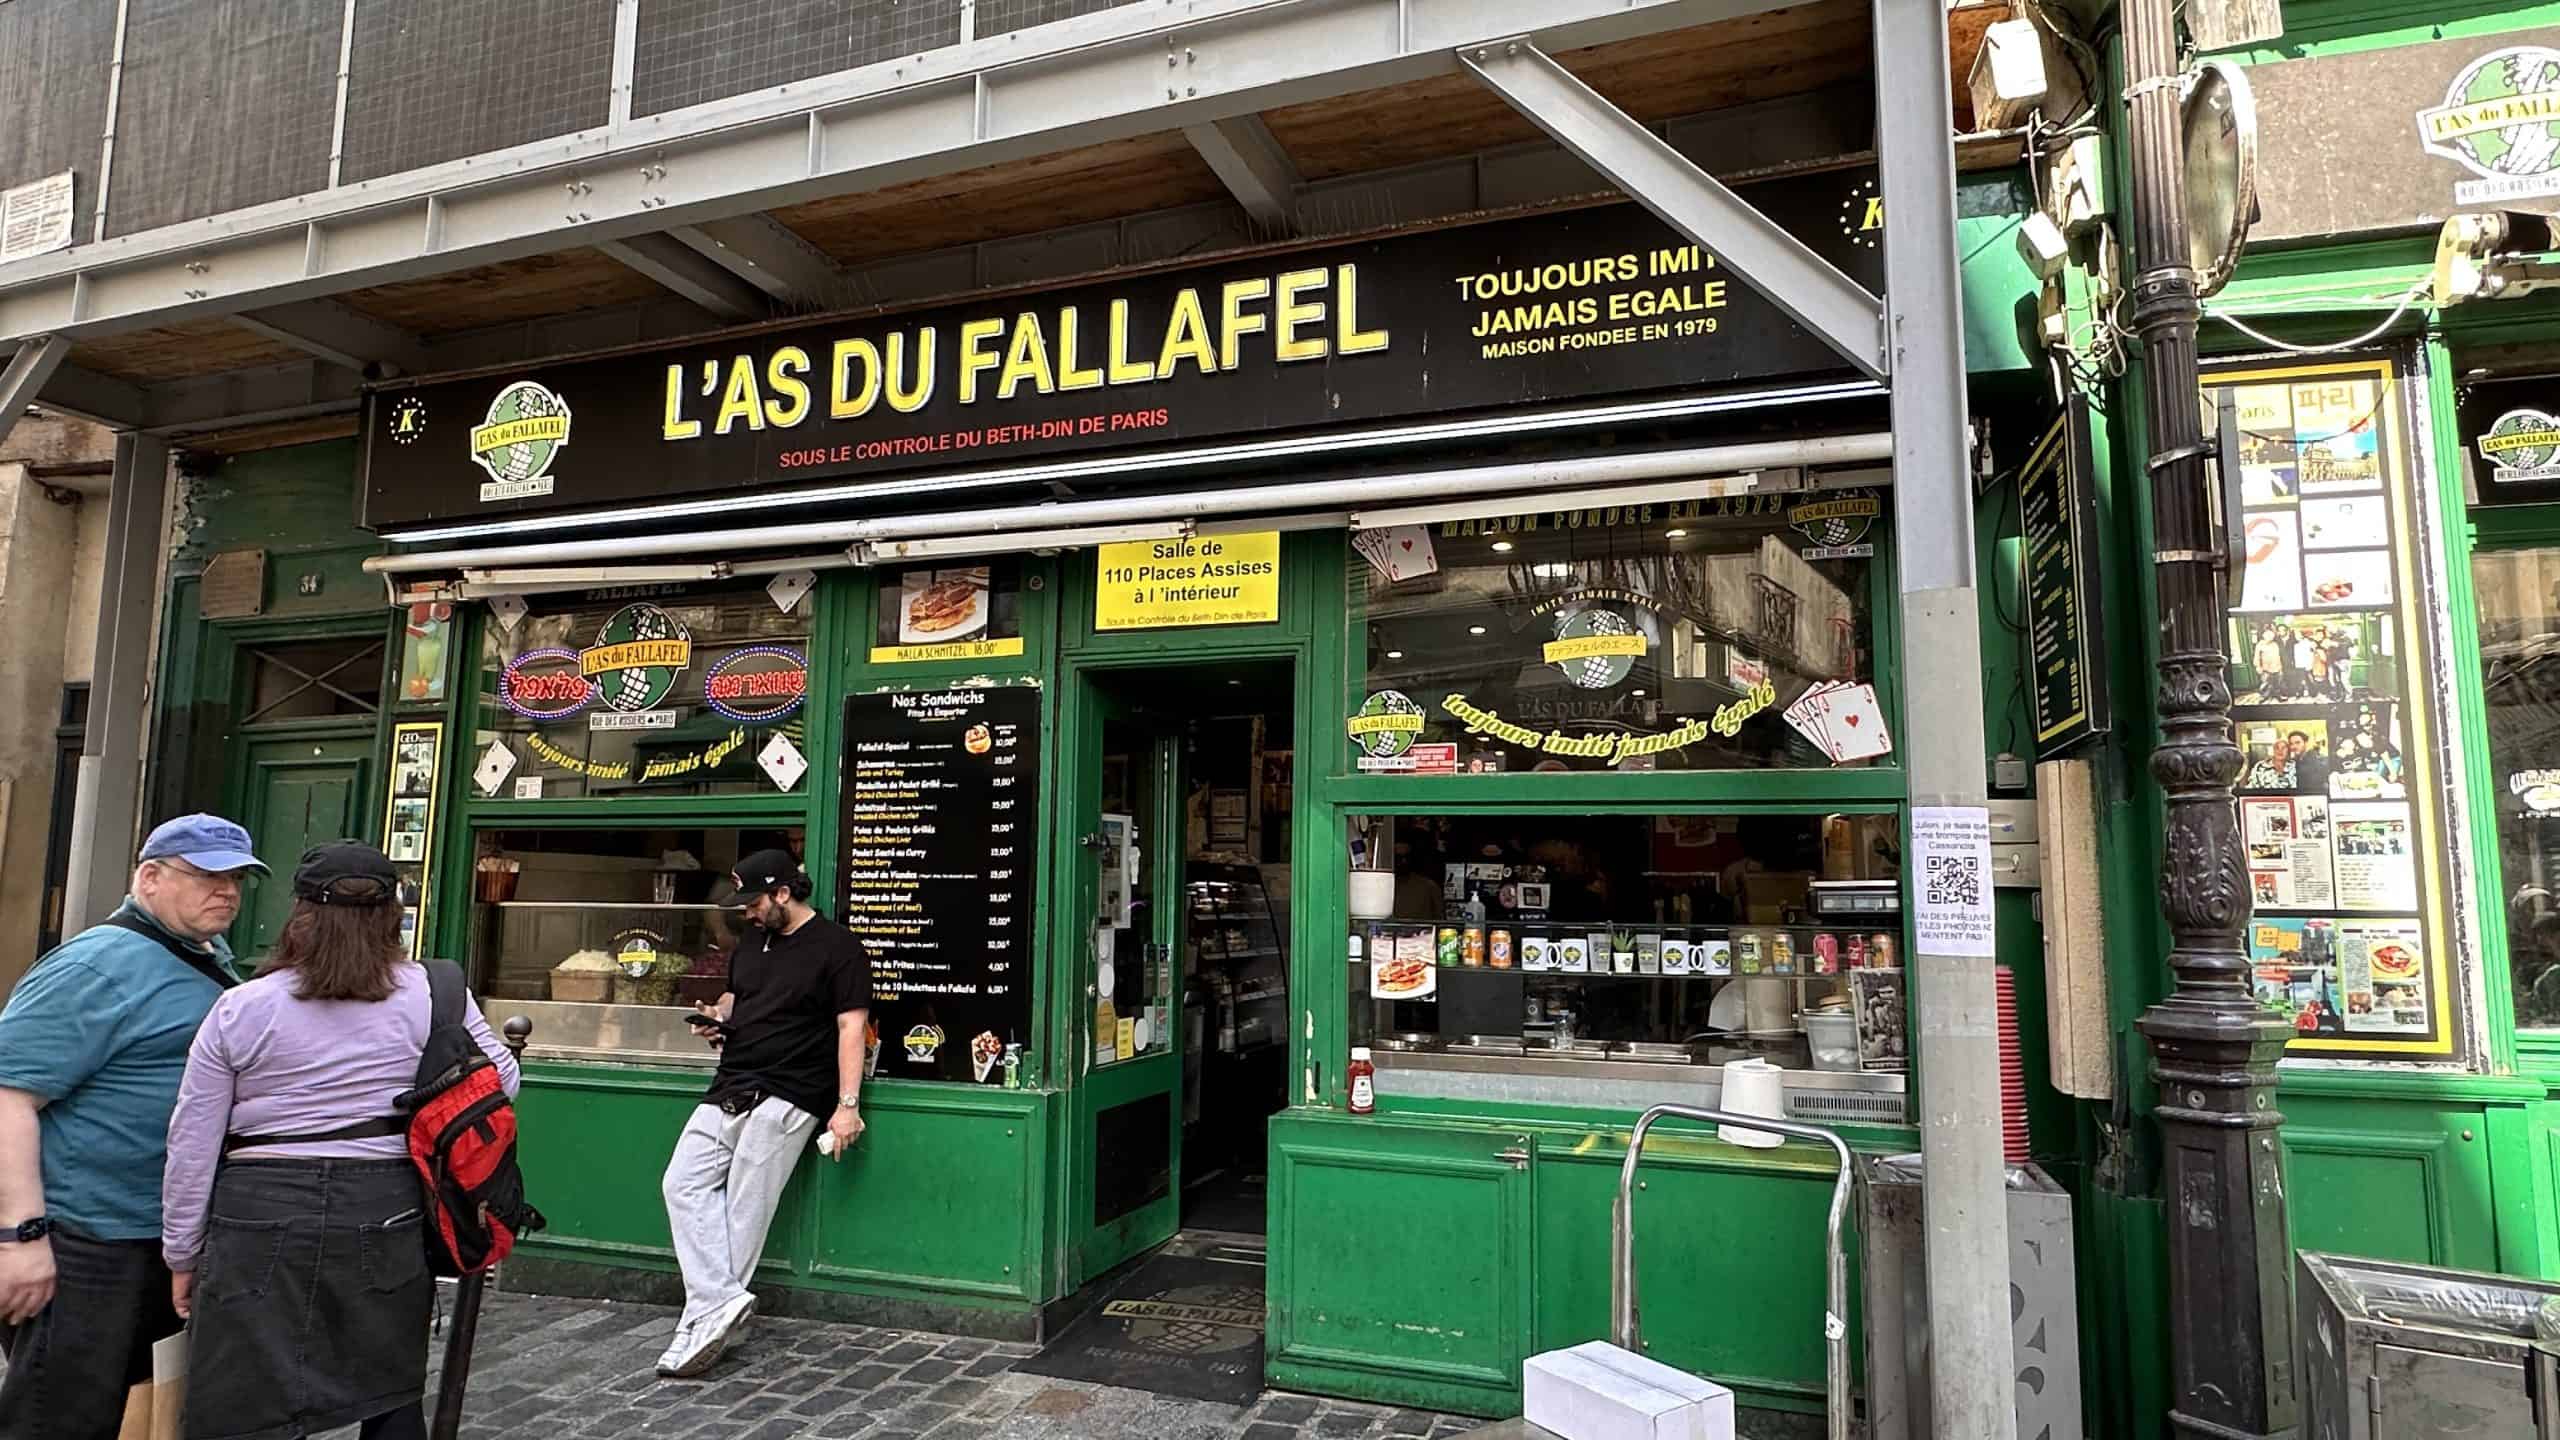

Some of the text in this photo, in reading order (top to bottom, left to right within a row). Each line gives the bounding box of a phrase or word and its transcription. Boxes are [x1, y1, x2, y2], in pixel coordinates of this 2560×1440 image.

[2434, 112, 2472, 134] L'AS
[2479, 107, 2500, 121] du
[1456, 252, 1639, 301] TOUJOURS
[1472, 281, 1727, 337] JAMAIS EGALE
[664, 264, 1389, 440] L'AS DU FALLAFEL
[1482, 318, 1718, 359] MAISON FONDEE EN 1979
[2298, 385, 2356, 414] 파리
[399, 408, 418, 432] K
[479, 431, 498, 448] L'AS
[512, 420, 561, 438] FALLAFEL
[779, 408, 1169, 468] SOUS LE CONTROLE DU BETH-DIN DE PARIS
[1668, 500, 1700, 519] EN
[1717, 494, 1783, 517] 1979
[1826, 500, 1874, 516] FALLAFEL
[1153, 540, 1223, 559] Salle de
[1105, 560, 1272, 584] 110 Places Assises
[1134, 588, 1144, 604] à
[1530, 596, 1564, 617] IMITE
[586, 644, 684, 673] L'AS du FALLAFEL
[892, 690, 985, 708] Nos Sandwichs
[1442, 678, 1776, 767] toujours imité jamais égalé
[526, 725, 745, 784] toujours imité jamais égalé
